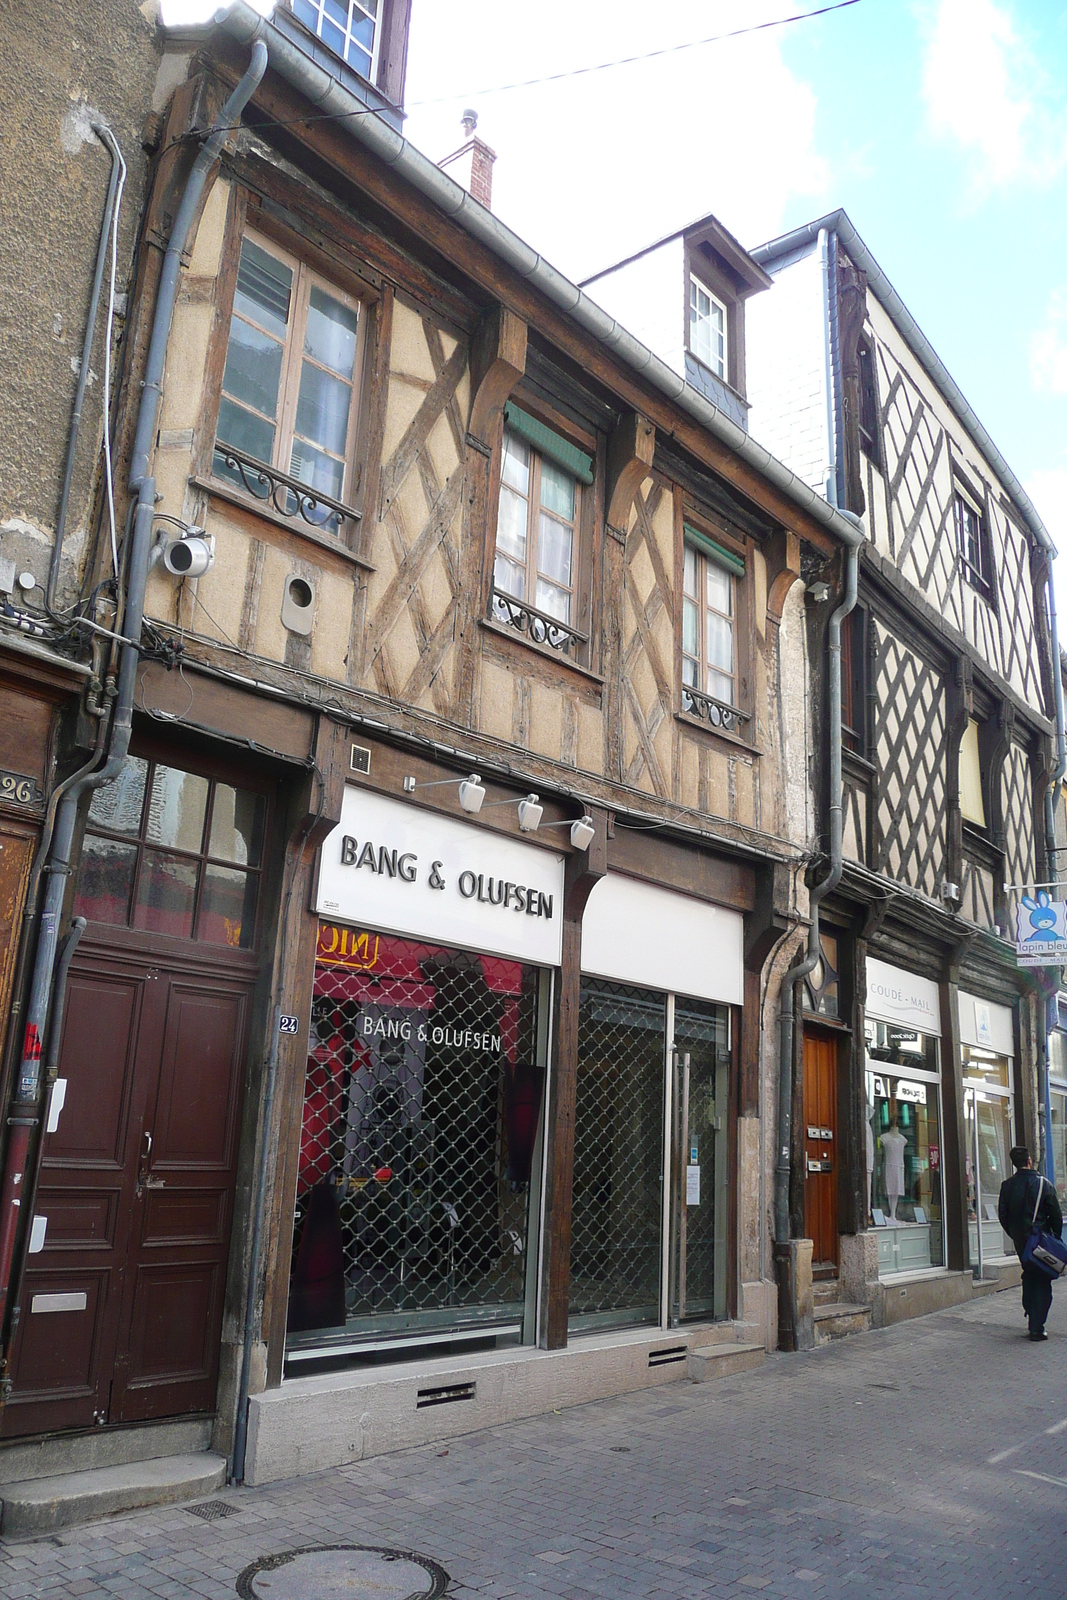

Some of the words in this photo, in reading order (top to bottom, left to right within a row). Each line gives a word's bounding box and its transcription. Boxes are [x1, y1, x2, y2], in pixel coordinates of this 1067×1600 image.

[0, 777, 30, 803] 26
[341, 835, 417, 882] BANG
[428, 860, 445, 890] &
[459, 870, 553, 919] OLUFSEN
[1019, 942, 1044, 953] lapin
[870, 983, 902, 1002] COUDÉ
[911, 996, 930, 1010] MAIL
[281, 1017, 296, 1032] 24
[363, 1016, 411, 1040] BANG
[417, 1024, 428, 1042] &
[432, 1026, 501, 1052] OLUFSEN
